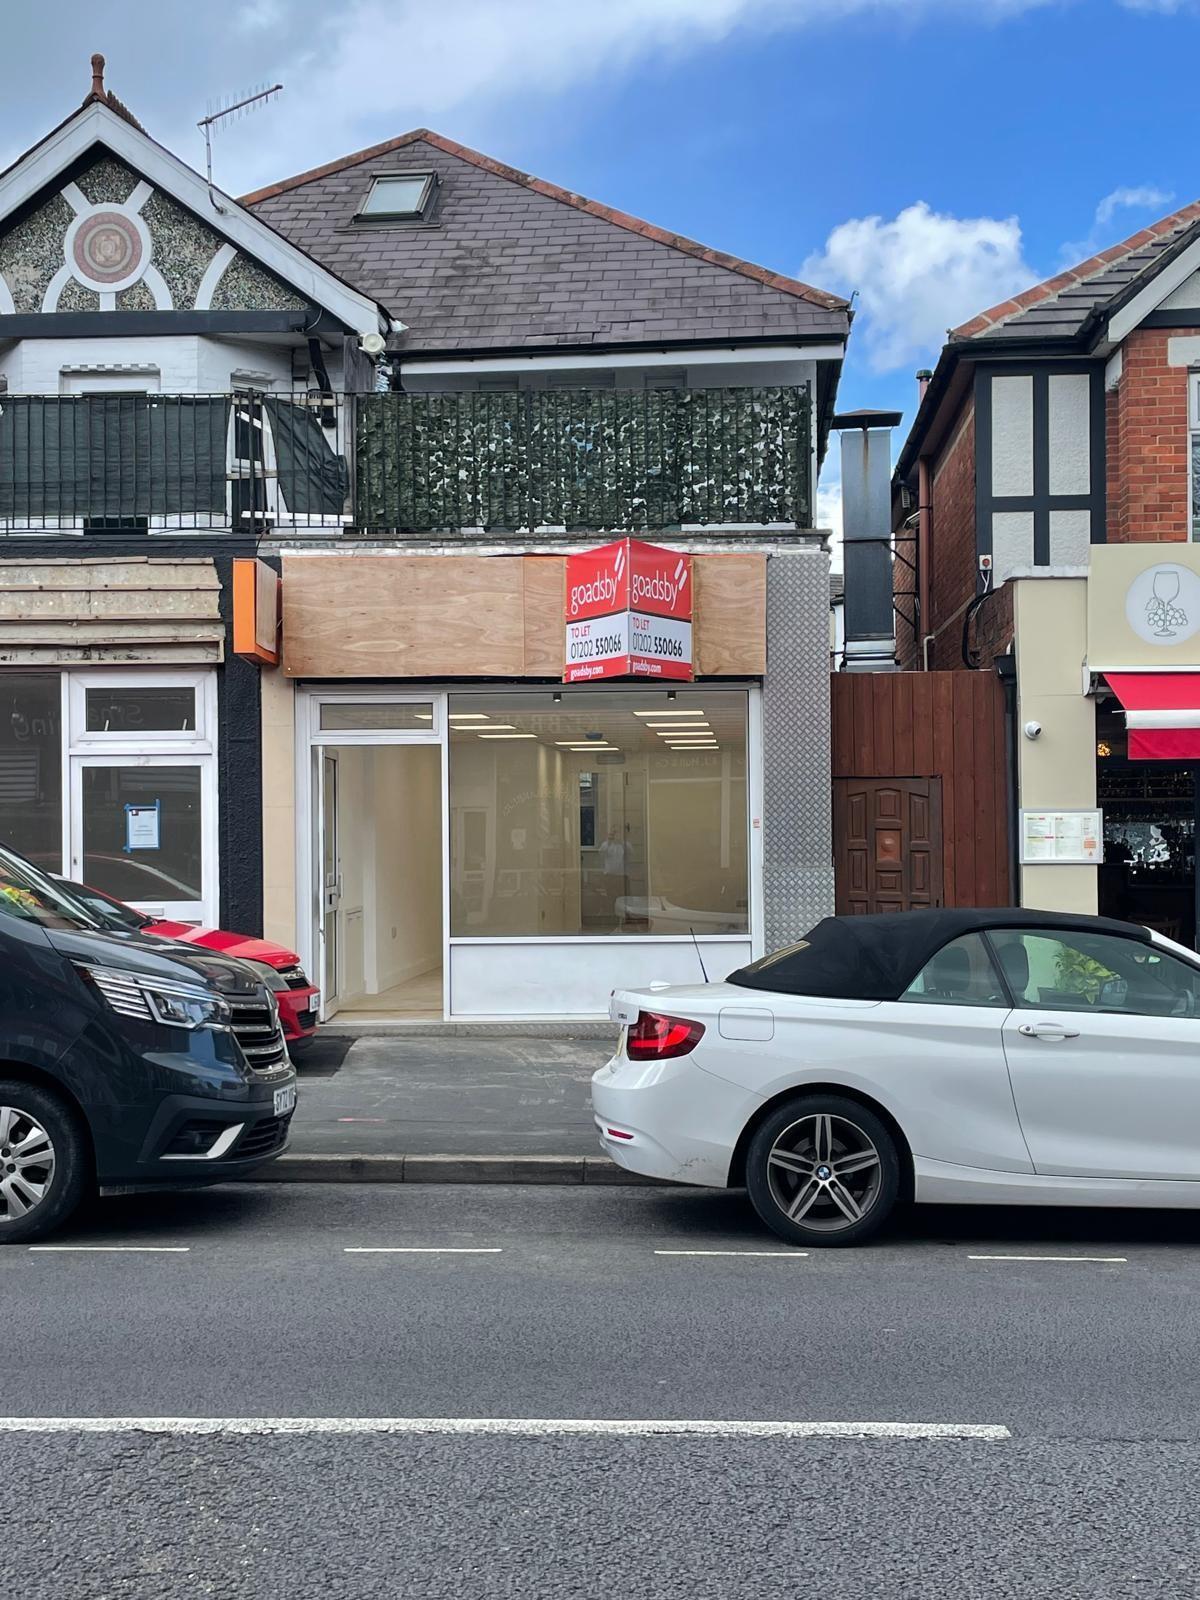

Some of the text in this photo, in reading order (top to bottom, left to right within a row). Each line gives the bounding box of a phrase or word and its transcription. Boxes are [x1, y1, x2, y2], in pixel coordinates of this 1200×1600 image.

[571, 569, 618, 615] goadsby
[632, 569, 678, 611] goadsby
[571, 625, 591, 638] TO LET
[632, 617, 650, 631] TO LET
[570, 634, 621, 659] 01202 550066
[632, 632, 683, 657] 01202 550066
[570, 665, 604, 681] goadsby.com
[632, 660, 662, 675] goadsby.com
